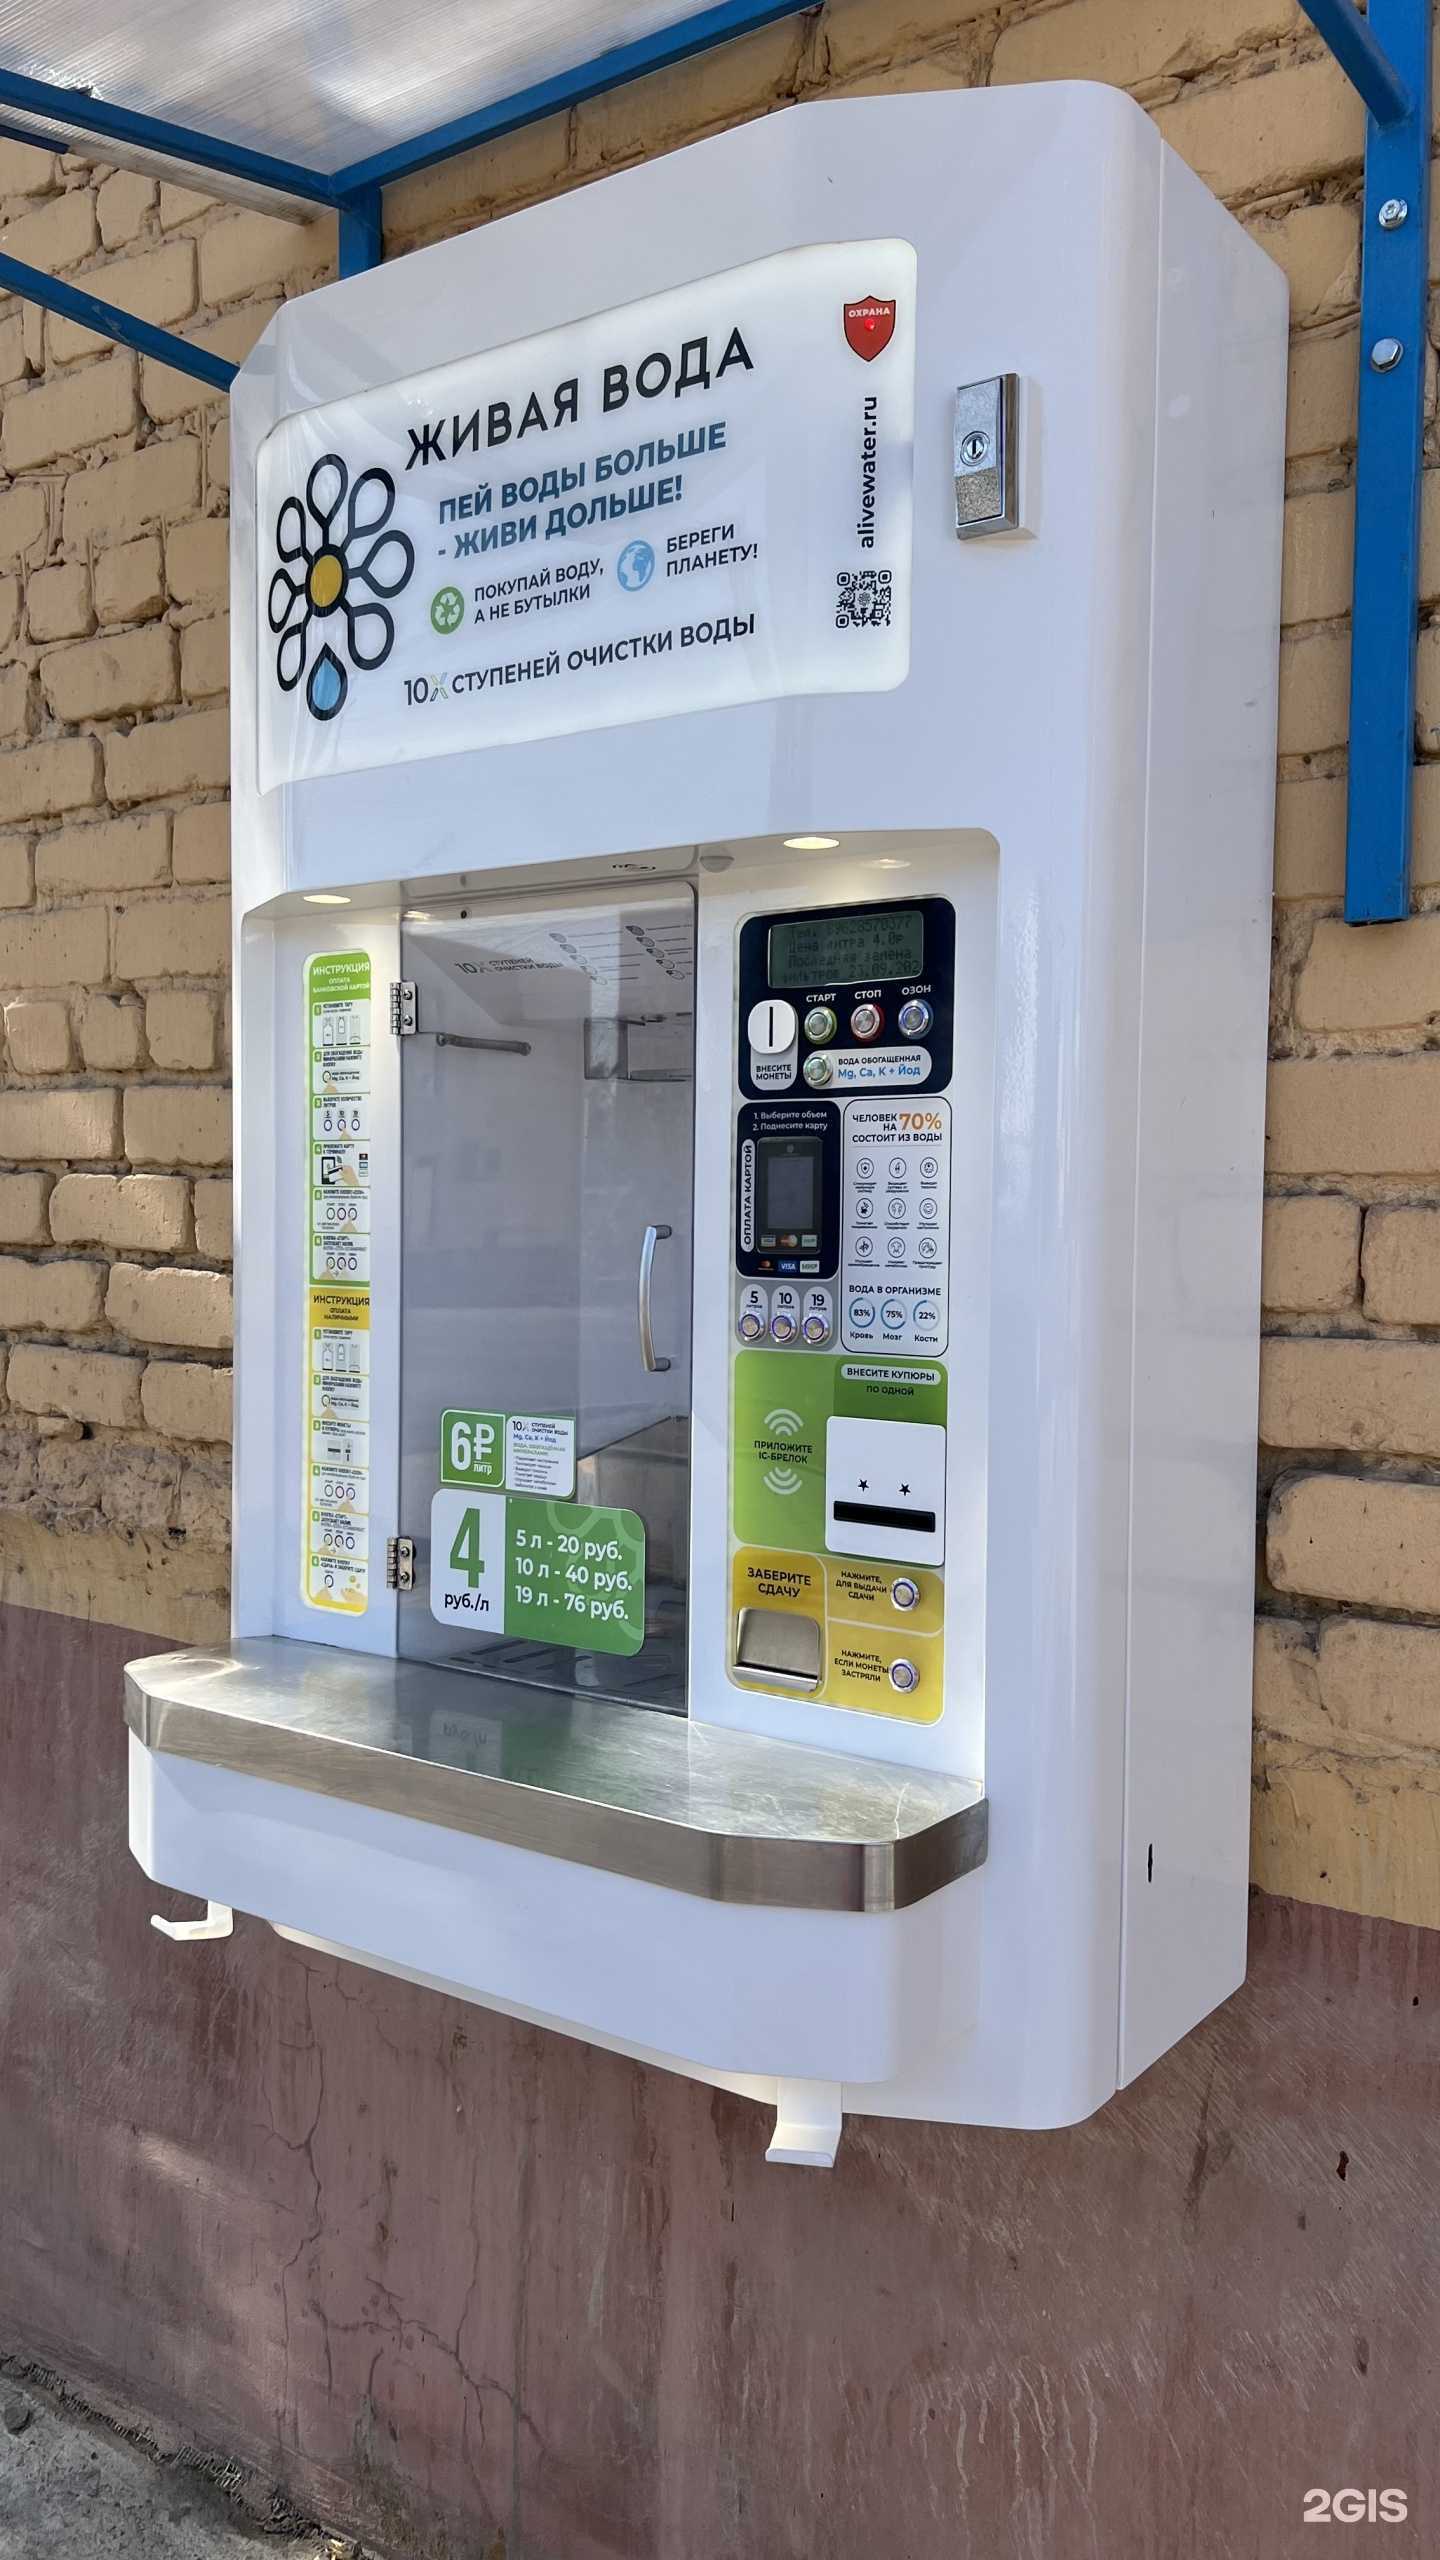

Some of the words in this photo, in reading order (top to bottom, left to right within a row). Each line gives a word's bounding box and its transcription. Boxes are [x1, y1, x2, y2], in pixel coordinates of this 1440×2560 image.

[848, 306, 891, 318] ОХРАНА
[404, 377, 579, 471] ЖИВАЯ
[602, 326, 754, 413] ВОДА
[439, 482, 493, 525] ПЕЙ
[501, 461, 586, 509] ВОДЫ
[594, 421, 727, 484] БОЛЬШЕ
[857, 396, 878, 549] alivewater.ru
[453, 514, 538, 559] ЖИВИ
[544, 473, 683, 541] ДОЛЬШЕ!
[666, 523, 735, 554] БЕРЕГИ
[666, 543, 759, 578] ПЛАНЕТУ!
[474, 567, 551, 603] ПОКУПАЙ
[555, 557, 605, 585] ВОДУ,
[474, 609, 486, 624] А
[489, 602, 511, 622] НЕ
[514, 584, 591, 616] БУТЫЛКИ
[452, 651, 561, 695] СТУПЕНЕЙ
[567, 630, 673, 672] ОЧИСТКИ
[680, 613, 756, 649] ВОДЫ
[312, 962, 369, 976] ИНСТРУКЦИЯ
[854, 989, 882, 1000] СТОП
[901, 984, 932, 995] ОЗОН
[806, 992, 837, 1003] СТАРТ
[838, 1057, 860, 1066] ВОДА
[861, 1054, 922, 1065] ОБОГАЩЕННАЯ
[755, 1064, 792, 1073] ВНЕСИТЕ
[838, 1067, 857, 1079] Mg,
[859, 1066, 876, 1078] Ca,
[898, 1064, 921, 1076] Йод
[755, 1072, 792, 1081] МОНЕТЫ
[760, 1111, 800, 1121] Выберите
[801, 1110, 828, 1119] объем
[852, 1113, 897, 1123] ЧЕЛОВЕК
[899, 1112, 943, 1131] 70%
[760, 1122, 803, 1131] Поднесите
[804, 1122, 828, 1132] карту
[883, 1123, 897, 1132] НА
[852, 1133, 896, 1143] СОСТОИТ
[898, 1133, 911, 1143] ИЗ
[913, 1133, 943, 1143] ВОДЫ
[743, 1144, 753, 1193] КАРТОЙ
[743, 1196, 752, 1246] ОПЛАТА
[750, 1290, 759, 1304] 5
[849, 1285, 874, 1294] ВОДА
[877, 1286, 883, 1294] В
[885, 1286, 942, 1296] ОРГАНИЗМЕ
[313, 1295, 370, 1306] ИНСТРУКЦИЯ
[779, 1292, 792, 1305] 10
[811, 1294, 825, 1306] 19
[853, 1308, 870, 1318] 83%
[886, 1310, 903, 1319] 75%
[918, 1311, 936, 1320] 22%
[850, 1332, 874, 1341] Кровь
[882, 1333, 903, 1341] Мозг
[914, 1334, 939, 1343] Кости
[847, 1367, 889, 1378] ВНЕСИТЕ
[891, 1369, 935, 1381] КУПЮРЫ
[866, 1385, 880, 1395] ПО
[881, 1386, 915, 1397] ОДНОЙ
[754, 1440, 813, 1454] ПРИЛОЖИТЕ
[759, 1451, 808, 1464] IC-БРЕЛОК
[473, 1463, 492, 1475] литр
[450, 1507, 485, 1589] 4
[516, 1530, 526, 1547] 5
[530, 1534, 542, 1549] л
[558, 1535, 580, 1554] 20
[584, 1540, 623, 1561] руб.
[515, 1557, 534, 1576] 10
[537, 1563, 549, 1579] л
[565, 1565, 589, 1585] 40
[594, 1571, 633, 1592] руб.
[747, 1567, 812, 1586] ЗАБЕРИТЕ
[841, 1570, 883, 1584] НАЖМИТЕ,
[758, 1583, 801, 1598] СДАЧУ
[835, 1579, 852, 1588] ДЛЯ
[853, 1581, 887, 1593] ВЫДАЧИ
[444, 1593, 489, 1612] руб./л
[515, 1585, 533, 1605] 19
[536, 1591, 548, 1607] л
[563, 1593, 587, 1613] 76
[590, 1600, 629, 1621] руб.
[848, 1591, 875, 1601] СДАЧИ
[841, 1649, 882, 1663] НАЖМИТЕ,
[834, 1658, 853, 1668] ЕСЛИ
[855, 1660, 889, 1674] МОНЕТЫ
[841, 1669, 881, 1682] ЗАСТРЯЛИ
